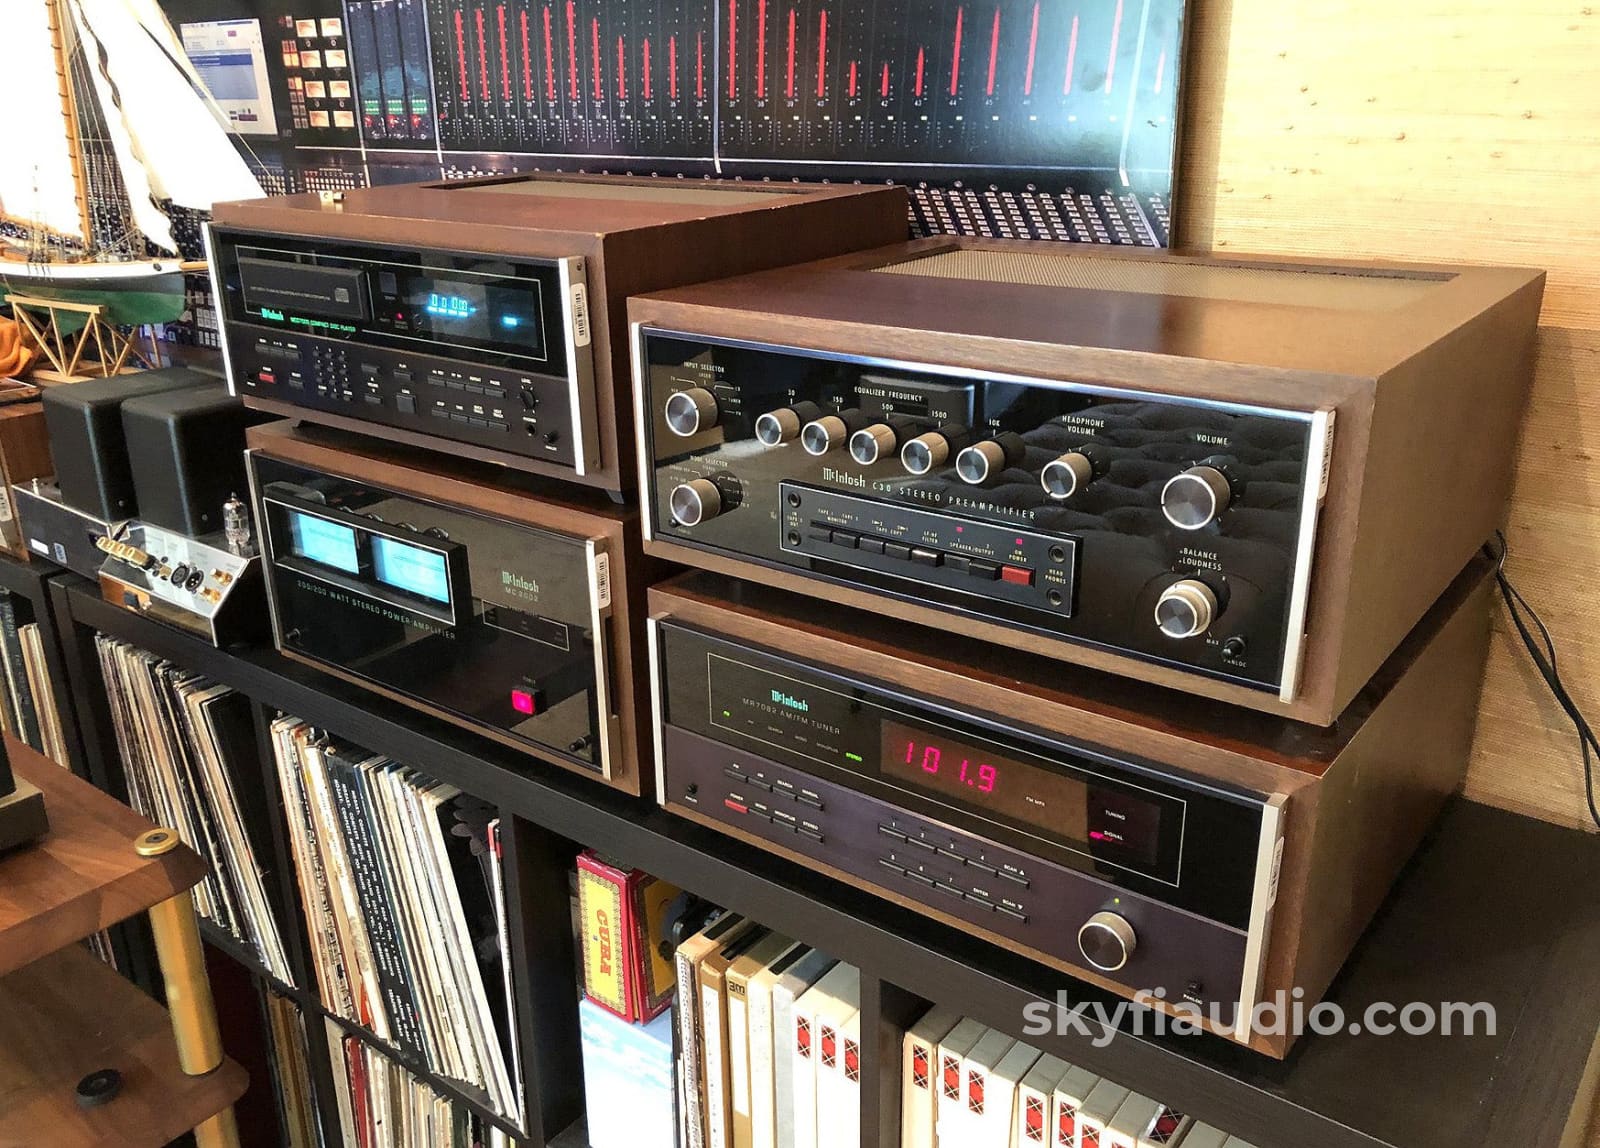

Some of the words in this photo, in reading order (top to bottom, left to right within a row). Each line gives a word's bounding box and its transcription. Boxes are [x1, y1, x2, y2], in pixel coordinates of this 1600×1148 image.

[700, 364, 725, 373] SELECTOR
[787, 389, 796, 397] 30
[854, 386, 886, 397] EQUALIZER
[888, 390, 923, 402] FREQUENCY
[833, 396, 844, 404] 150
[881, 402, 894, 412] 500
[931, 409, 947, 419] 1500
[1062, 415, 1105, 428] HEADPHONE
[1068, 425, 1096, 436] VOLUME
[1196, 433, 1229, 446] VOLUME
[823, 467, 866, 488] McIntosh
[900, 487, 941, 502] STEREO
[948, 496, 1036, 520] PREAMPLIFIER
[1008, 554, 1027, 563] POWER
[1183, 547, 1217, 560] BALANCE
[1182, 558, 1222, 571] LOUDNESS
[502, 571, 539, 593] McIntosh
[1044, 574, 1067, 585] PHONES
[330, 592, 349, 604] WATT
[351, 599, 380, 615] STEREO
[383, 609, 410, 625] POWER
[412, 620, 456, 640] AMPLIFIER
[771, 689, 809, 712] McIntosh
[780, 708, 809, 725] AM/FM
[812, 720, 840, 735] TUNER
[905, 741, 996, 793] 101.9
[341, 807, 351, 834] COMPLETE
[349, 812, 359, 840] COMPLETE
[358, 818, 368, 846] COMPLETE
